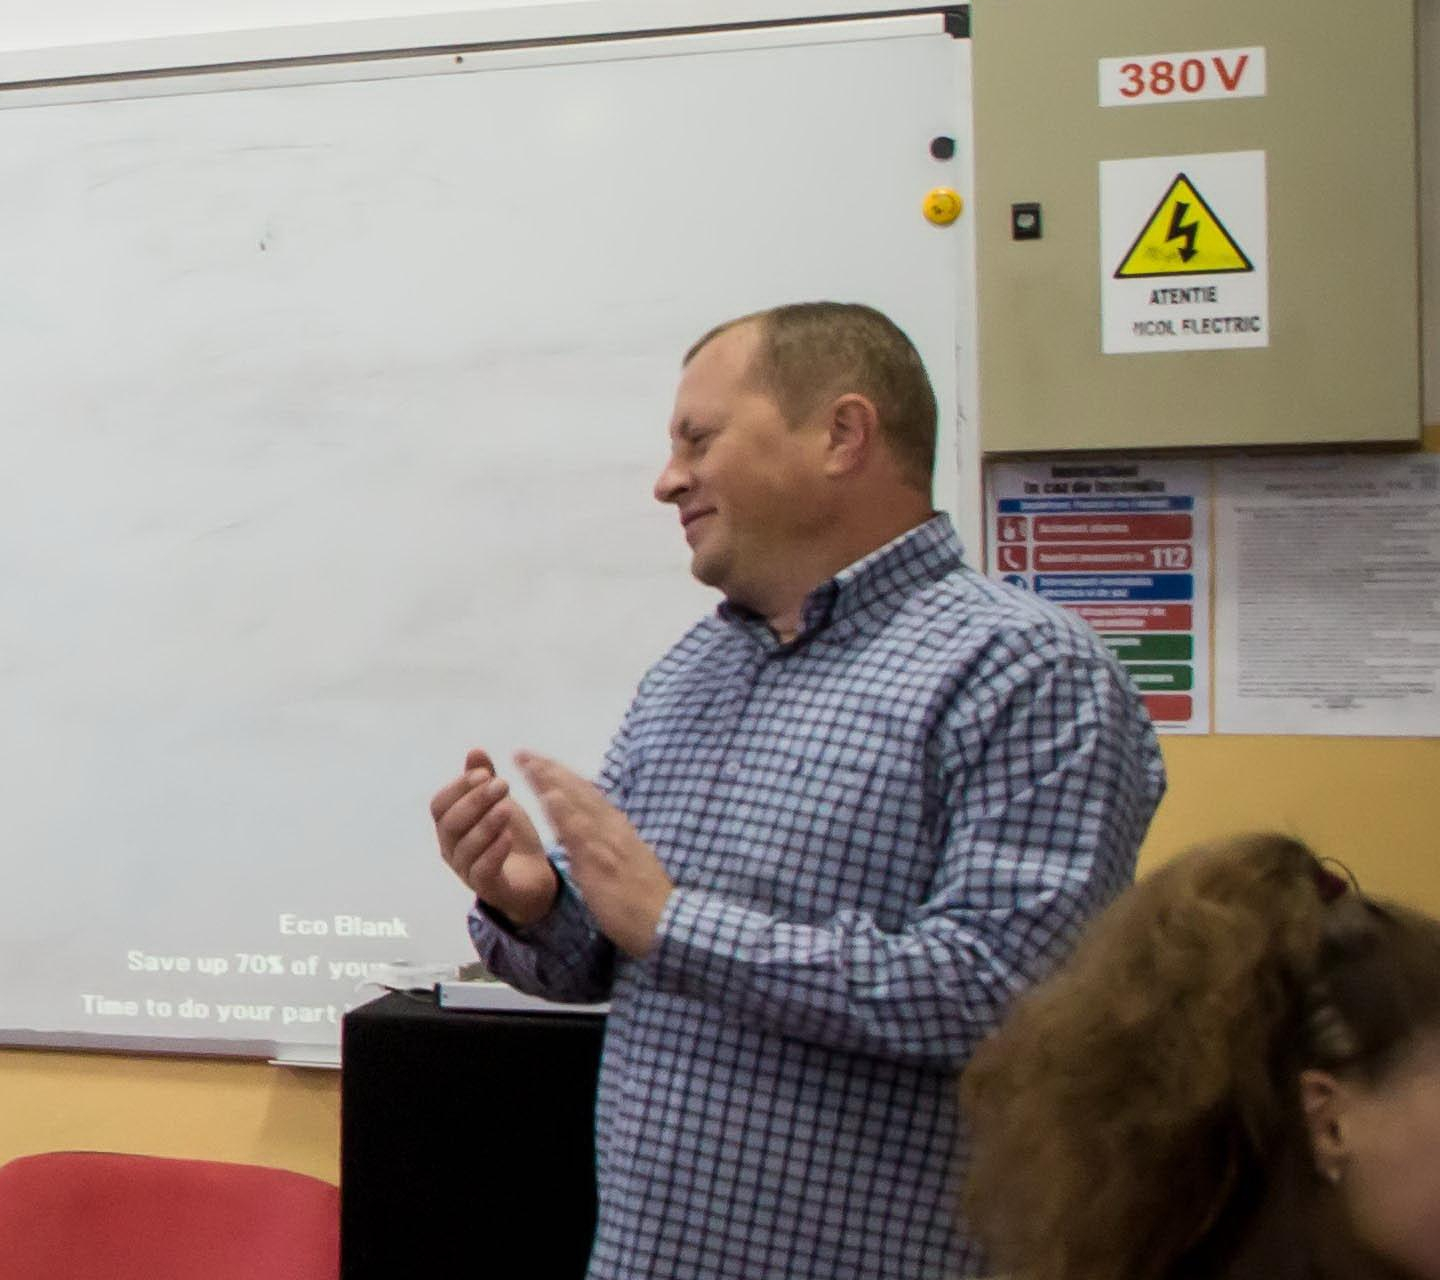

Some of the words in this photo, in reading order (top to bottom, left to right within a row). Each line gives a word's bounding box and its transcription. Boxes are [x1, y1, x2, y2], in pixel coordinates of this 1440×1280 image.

[1118, 54, 1249, 98] 380V
[1150, 286, 1218, 306] ATENTIE
[1149, 547, 1188, 569] 112
[280, 913, 328, 936] Eco
[334, 914, 409, 938] Blank
[127, 950, 190, 973] Save
[198, 955, 228, 976] up
[235, 952, 283, 975] 70%
[291, 954, 319, 976] of
[81, 993, 138, 1017] Time
[147, 995, 173, 1018] to
[179, 996, 210, 1019] do
[216, 1001, 274, 1023] your
[282, 1000, 338, 1024] part
